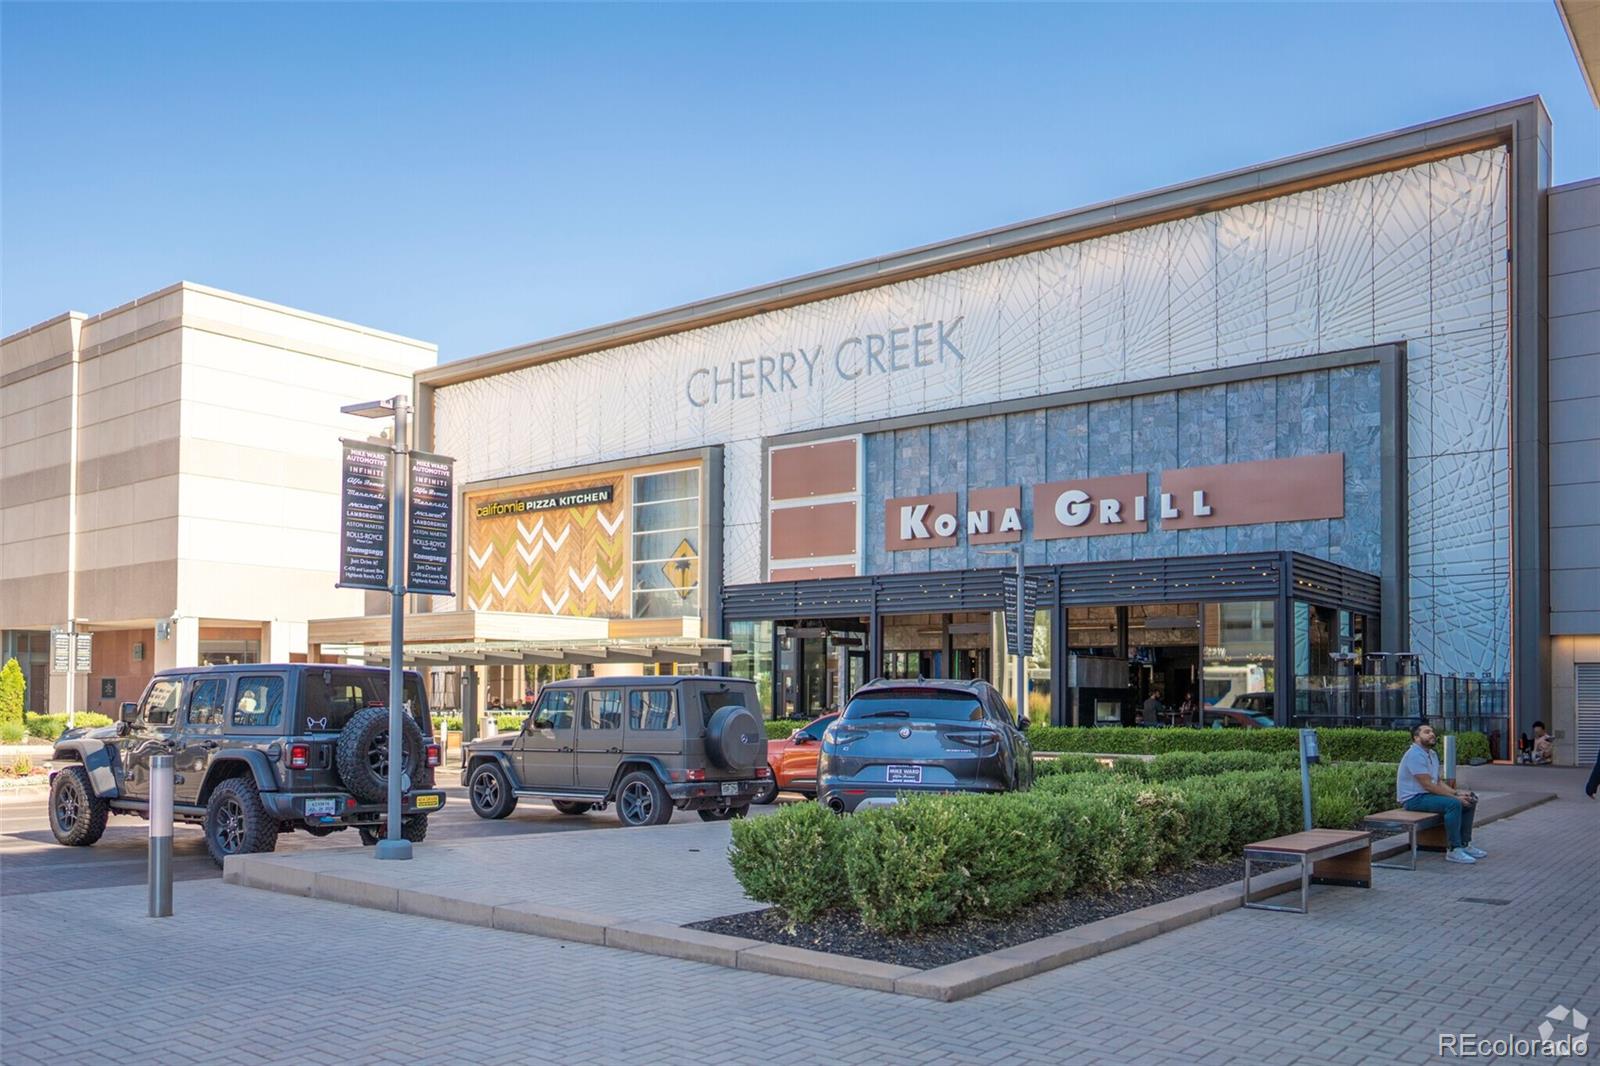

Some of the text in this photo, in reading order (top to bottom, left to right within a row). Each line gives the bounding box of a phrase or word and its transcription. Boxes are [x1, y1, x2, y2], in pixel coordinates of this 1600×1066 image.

[687, 316, 966, 408] CHERRY CREEK
[351, 449, 366, 457] MIKE
[346, 455, 387, 466] AUTOMOTIVE
[412, 466, 450, 476] AUTOMOTIVE
[431, 462, 448, 470] WARD
[350, 466, 384, 477] INFINITI
[416, 476, 446, 486] INFINITI
[346, 489, 386, 500] Maserati
[413, 486, 448, 497] Alfa Romeo
[476, 491, 608, 516] california PIZZA KITCHEN
[346, 510, 384, 520] LAMBORGHINI
[900, 490, 1213, 540] KONA GRILL
[412, 519, 448, 528] LAMBORGHINI
[346, 531, 383, 541] ROLLS-ROYCE
[412, 539, 446, 548] ROLLS-ROYCE
[346, 546, 384, 556] Koenigsegg
